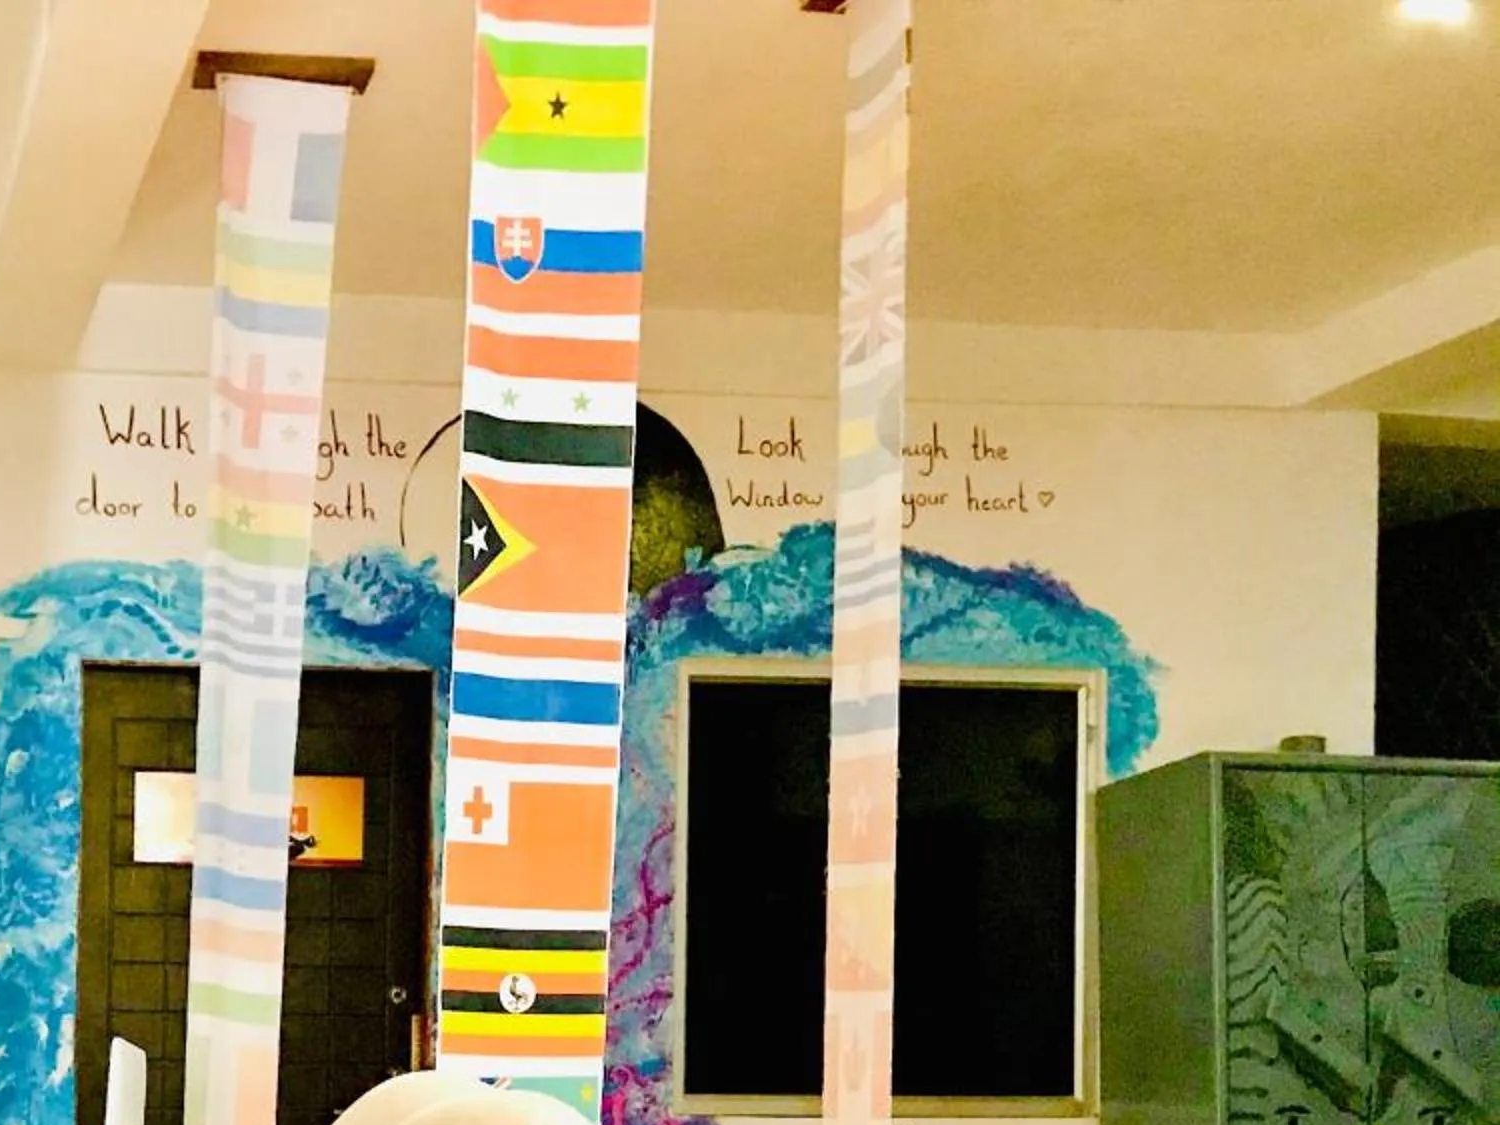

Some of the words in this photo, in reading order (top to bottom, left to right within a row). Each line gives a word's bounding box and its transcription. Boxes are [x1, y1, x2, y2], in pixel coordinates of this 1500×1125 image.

[98, 403, 196, 455] Walk
[365, 412, 408, 459] the
[736, 415, 806, 462] Look
[971, 424, 1009, 462] the
[75, 472, 143, 518] door
[171, 480, 197, 519] to
[726, 478, 824, 509] Window
[901, 493, 949, 529] your
[964, 474, 1030, 513] heart
